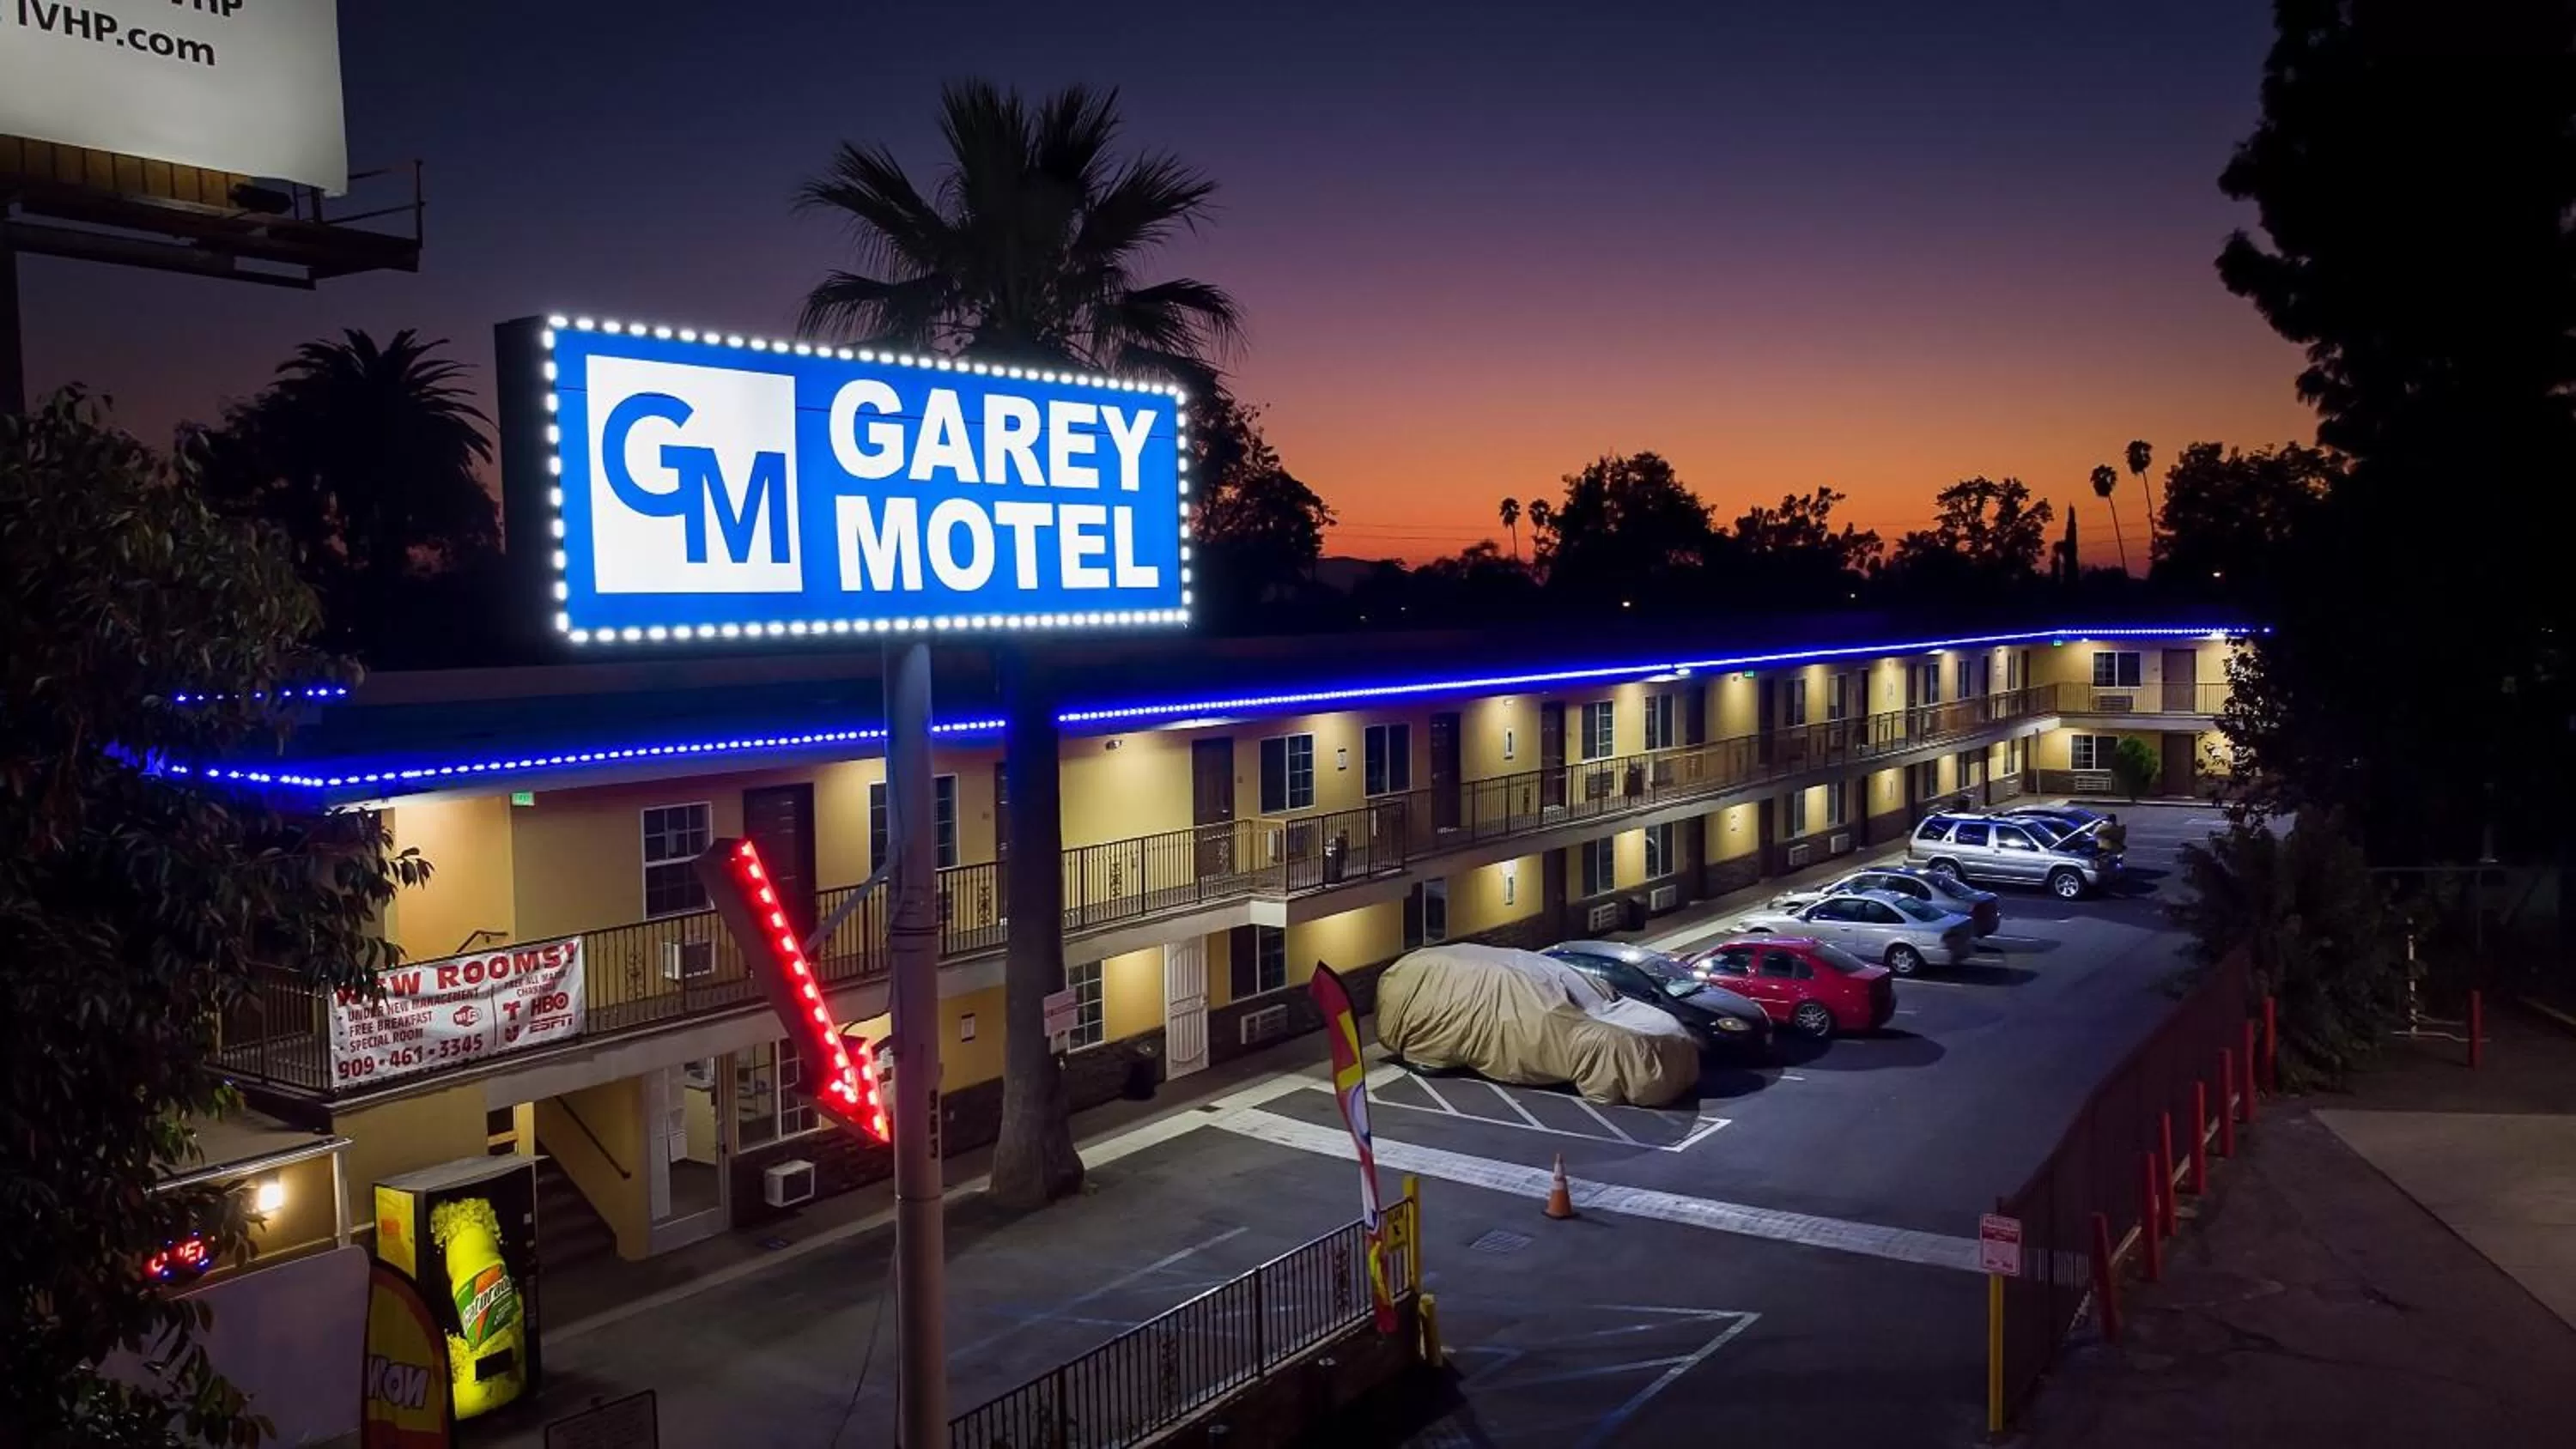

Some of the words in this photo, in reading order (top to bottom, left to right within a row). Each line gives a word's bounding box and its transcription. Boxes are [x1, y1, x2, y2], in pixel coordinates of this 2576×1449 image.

[829, 379, 1157, 491] GAREY
[602, 392, 790, 564] GM
[835, 495, 1159, 591] MOTEL
[337, 972, 421, 1006] NW
[412, 987, 479, 1009] MANAGEMENT
[531, 991, 568, 1016] HBO
[349, 1022, 374, 1037] FREE
[378, 1011, 433, 1031] BREAKFAST
[530, 1014, 573, 1034] ESPN
[349, 1035, 389, 1052] SPECIAL
[393, 1028, 423, 1043] ROOM
